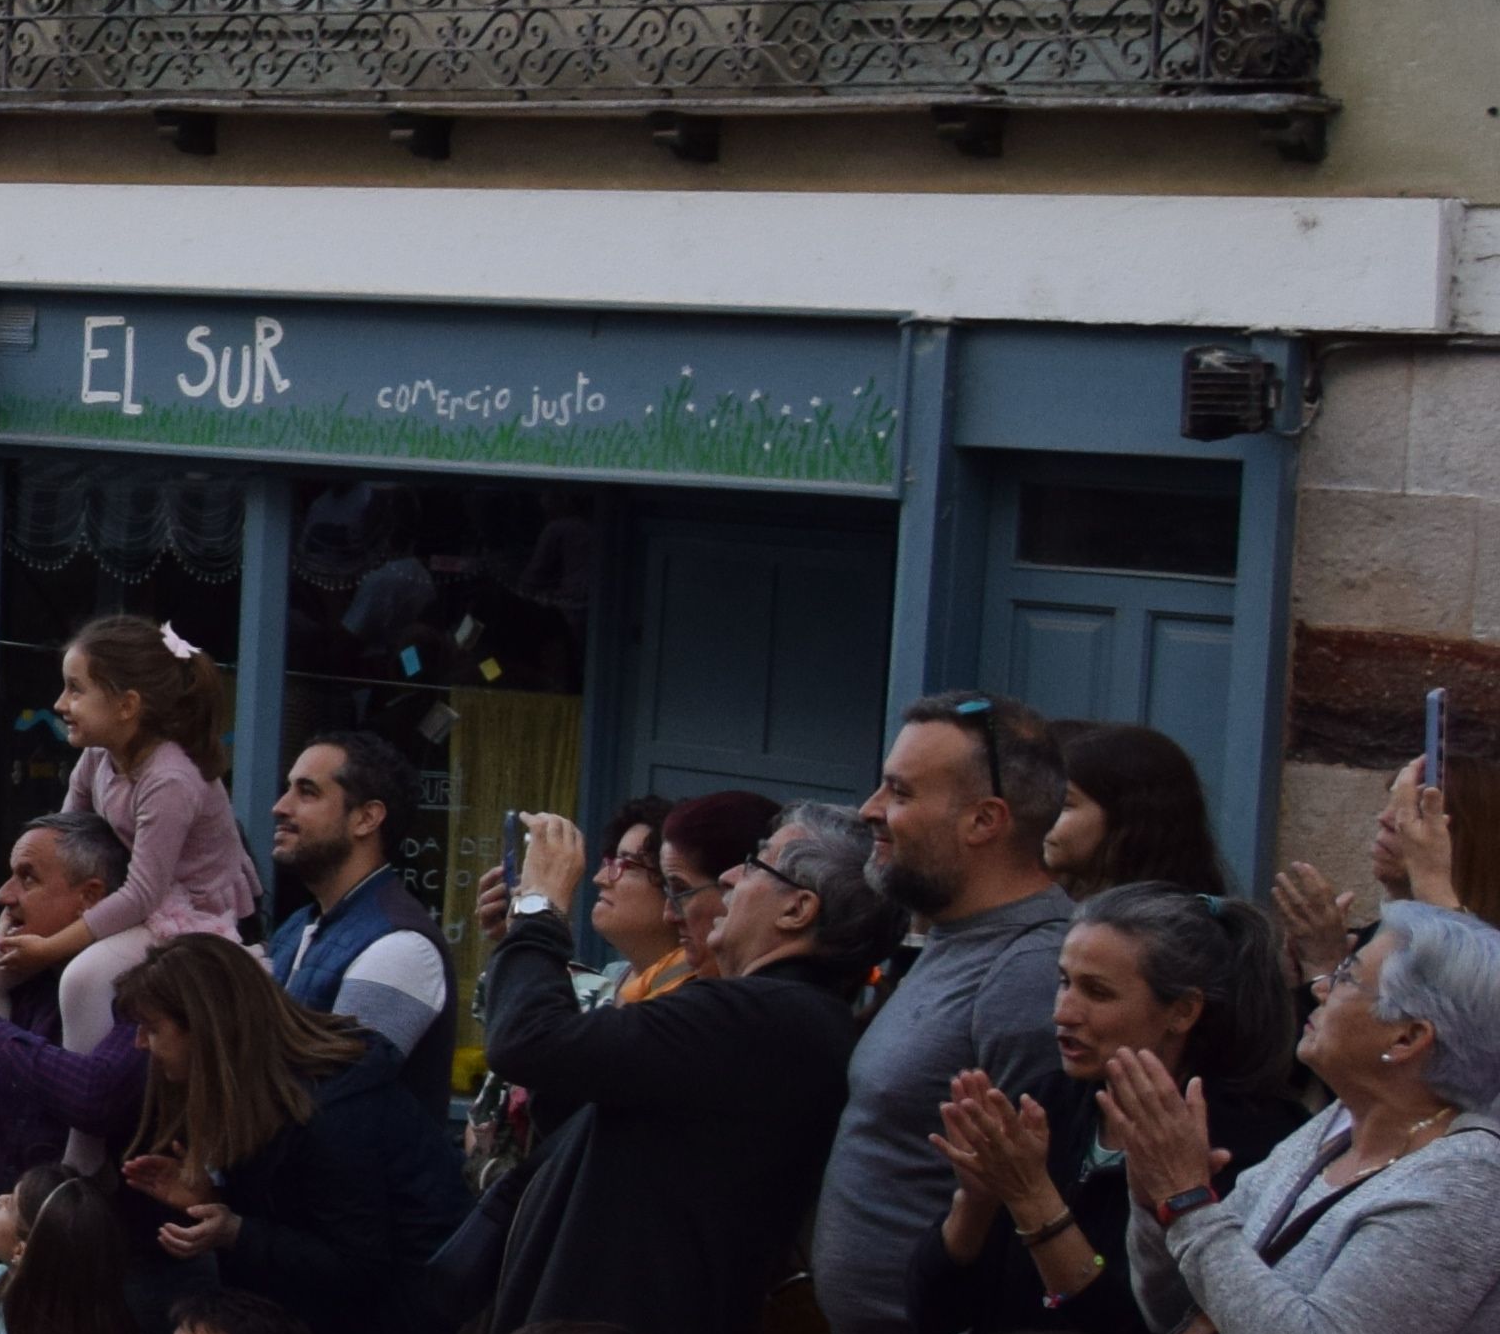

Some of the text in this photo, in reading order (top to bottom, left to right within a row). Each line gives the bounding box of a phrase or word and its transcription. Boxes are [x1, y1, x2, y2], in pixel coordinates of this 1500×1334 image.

[81, 316, 291, 415] EL SUR
[521, 371, 606, 428] justo
